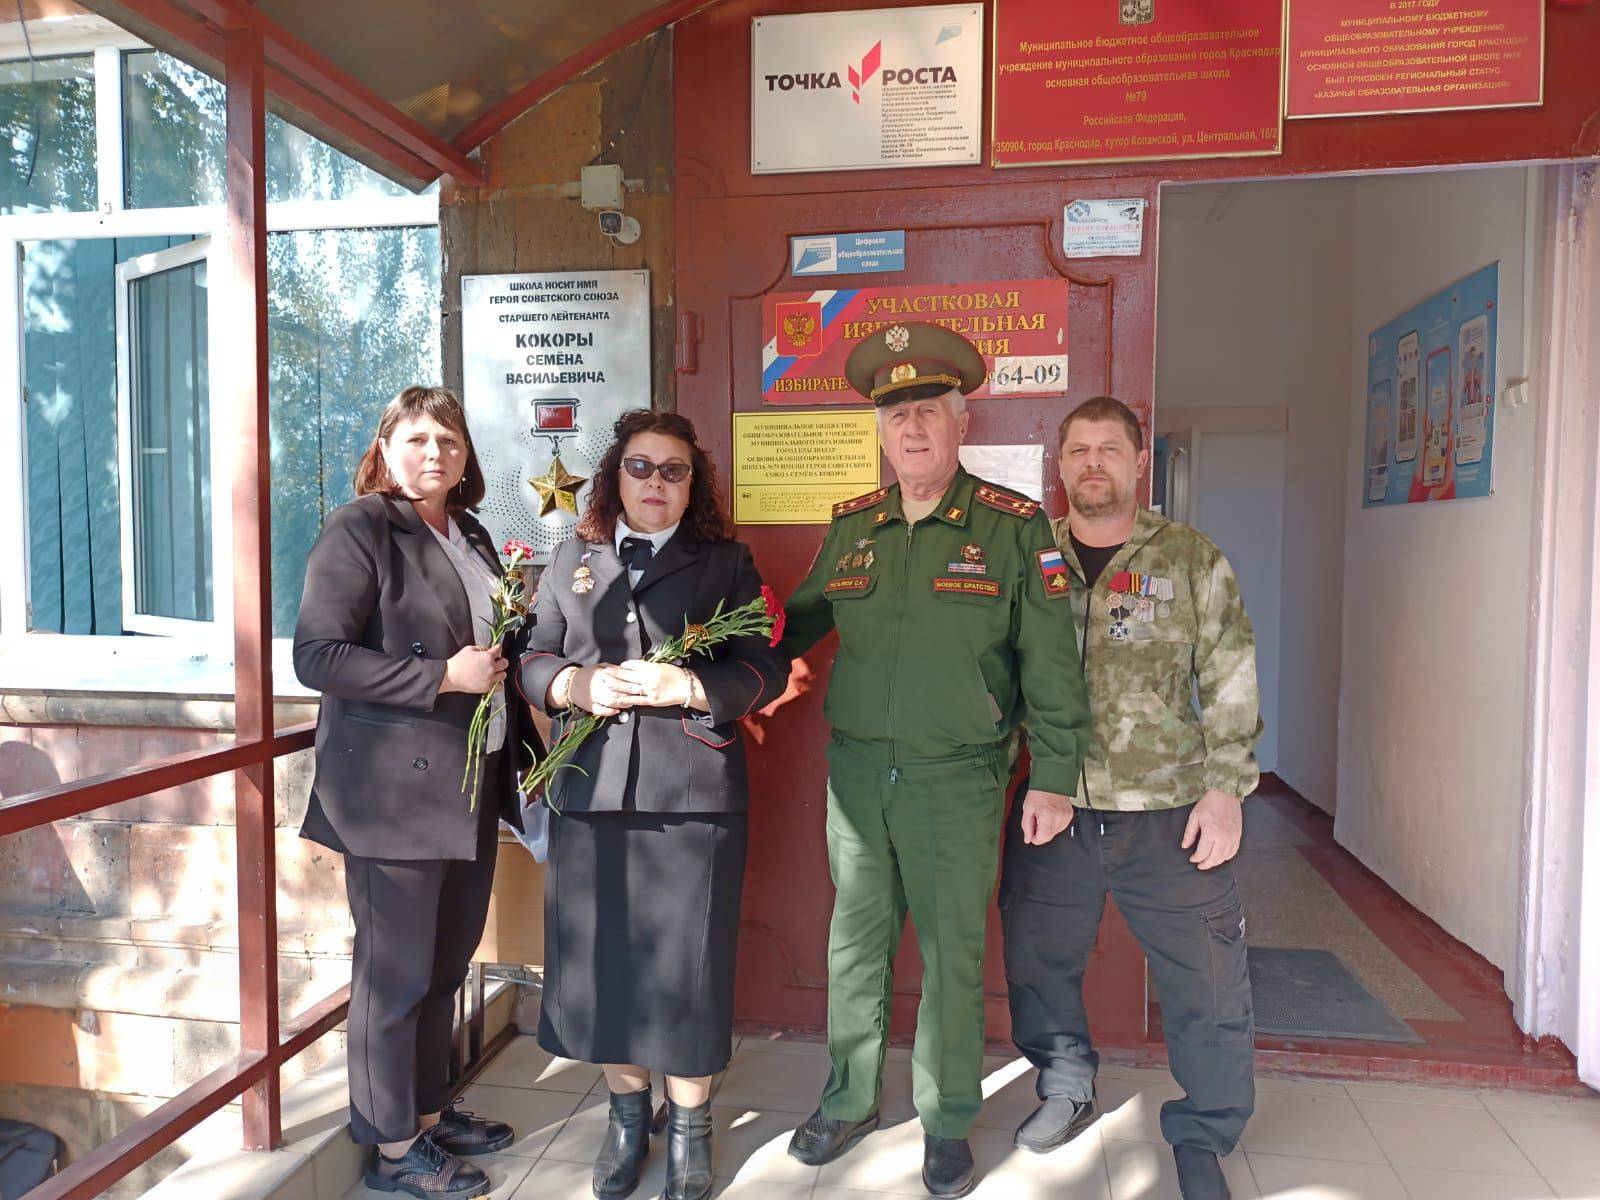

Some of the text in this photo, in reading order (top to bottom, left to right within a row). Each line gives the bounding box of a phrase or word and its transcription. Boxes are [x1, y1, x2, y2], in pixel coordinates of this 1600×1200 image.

[1398, 1, 1415, 9] 2017
[1341, 10, 1488, 27] МУНИЦИПАЛЬНОМУ БЮДЖЕТНОМУ
[1325, 24, 1504, 42] ОБЩЕОБРАЗОВАТЕЛЬНОМУ УЧРЕЖДЕНИЮ
[1020, 29, 1260, 54] Муниципальное бюджетное общеобразовательное
[1300, 46, 1380, 58] МУНИЦИПАЛЬНОГО
[1383, 42, 1445, 52] ОБРАЗОВАНИЯ
[1448, 40, 1476, 48] ГОРОД
[999, 46, 1280, 75] учреждение муниципального образования город Краснодар
[1307, 61, 1354, 71] ОСНОВНОЙ
[1357, 54, 1467, 68] ОБЩЕОБРАЗОВАТЕЛЬНОЙ
[1470, 52, 1500, 60] ШКОЛЕ
[765, 66, 957, 91] ТОЧКА РОСТА
[1046, 68, 1230, 88] основная общеобразовательная школа
[1326, 67, 1500, 84] БЫЛ ПРИСВОЕН РЕГИОНАЛЬНЫЙ СТАТУС
[1126, 90, 1147, 102] №79
[1358, 84, 1440, 96] ОБРАЗОВАТЕЛЬНАЯ
[1084, 112, 1186, 126] Российская Федерация,
[996, 141, 1026, 153] 350904,
[1029, 141, 1052, 152] город
[1055, 138, 1102, 150] Краснодар,
[1105, 138, 1128, 149] хутор
[1132, 133, 1179, 145] Копанской,
[1182, 134, 1193, 146] ул.
[1198, 129, 1257, 144] Центральная,
[856, 238, 885, 246] Цифровая
[838, 249, 902, 258] общеобразовательная
[510, 280, 598, 291] ШКОЛА НОСИТ ИМЯ
[490, 292, 619, 304] ГЕРОЯ СОВЕТСКОГО СОЮЗА
[867, 291, 1020, 314] УЧАСТКОВАЯ
[499, 311, 610, 323] СТАРШЕГО ЛЕЙТЕНАНТА
[844, 313, 1046, 338] ИЗТЕЛЬНАЯ
[516, 332, 593, 348] КОКОРЫ
[527, 351, 583, 365] СЕМЁНА
[507, 371, 605, 384] ВАСИЛЬЕВИЧА
[775, 377, 849, 392] ИЗБИРАТЕ
[997, 364, 1060, 386] 64-09
[964, 582, 996, 592] БРАТСТВО
